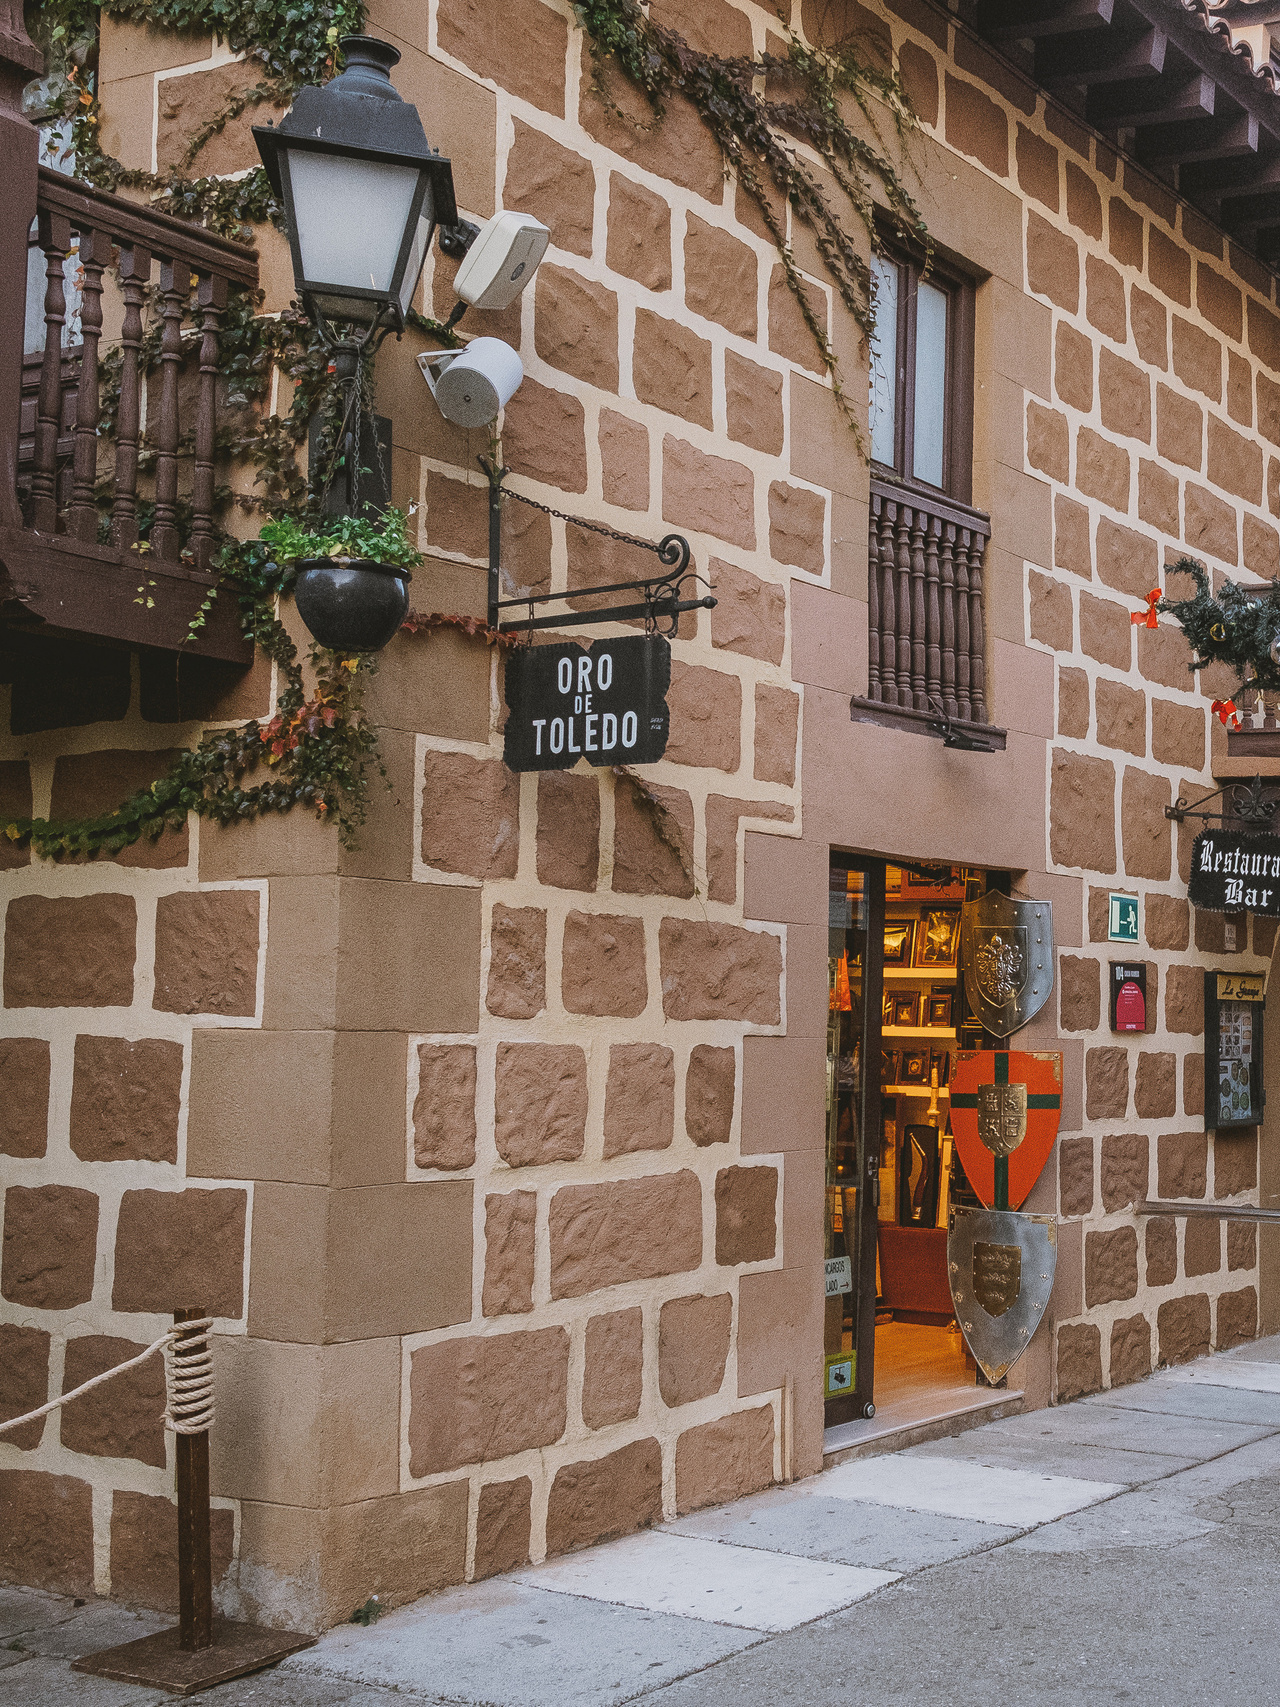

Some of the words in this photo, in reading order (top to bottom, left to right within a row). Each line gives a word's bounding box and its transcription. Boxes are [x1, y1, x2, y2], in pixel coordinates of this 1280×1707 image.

[557, 653, 613, 694] ORO
[574, 693, 593, 714] DE
[532, 710, 638, 756] TOLEDO
[1224, 877, 1273, 907] Bar
